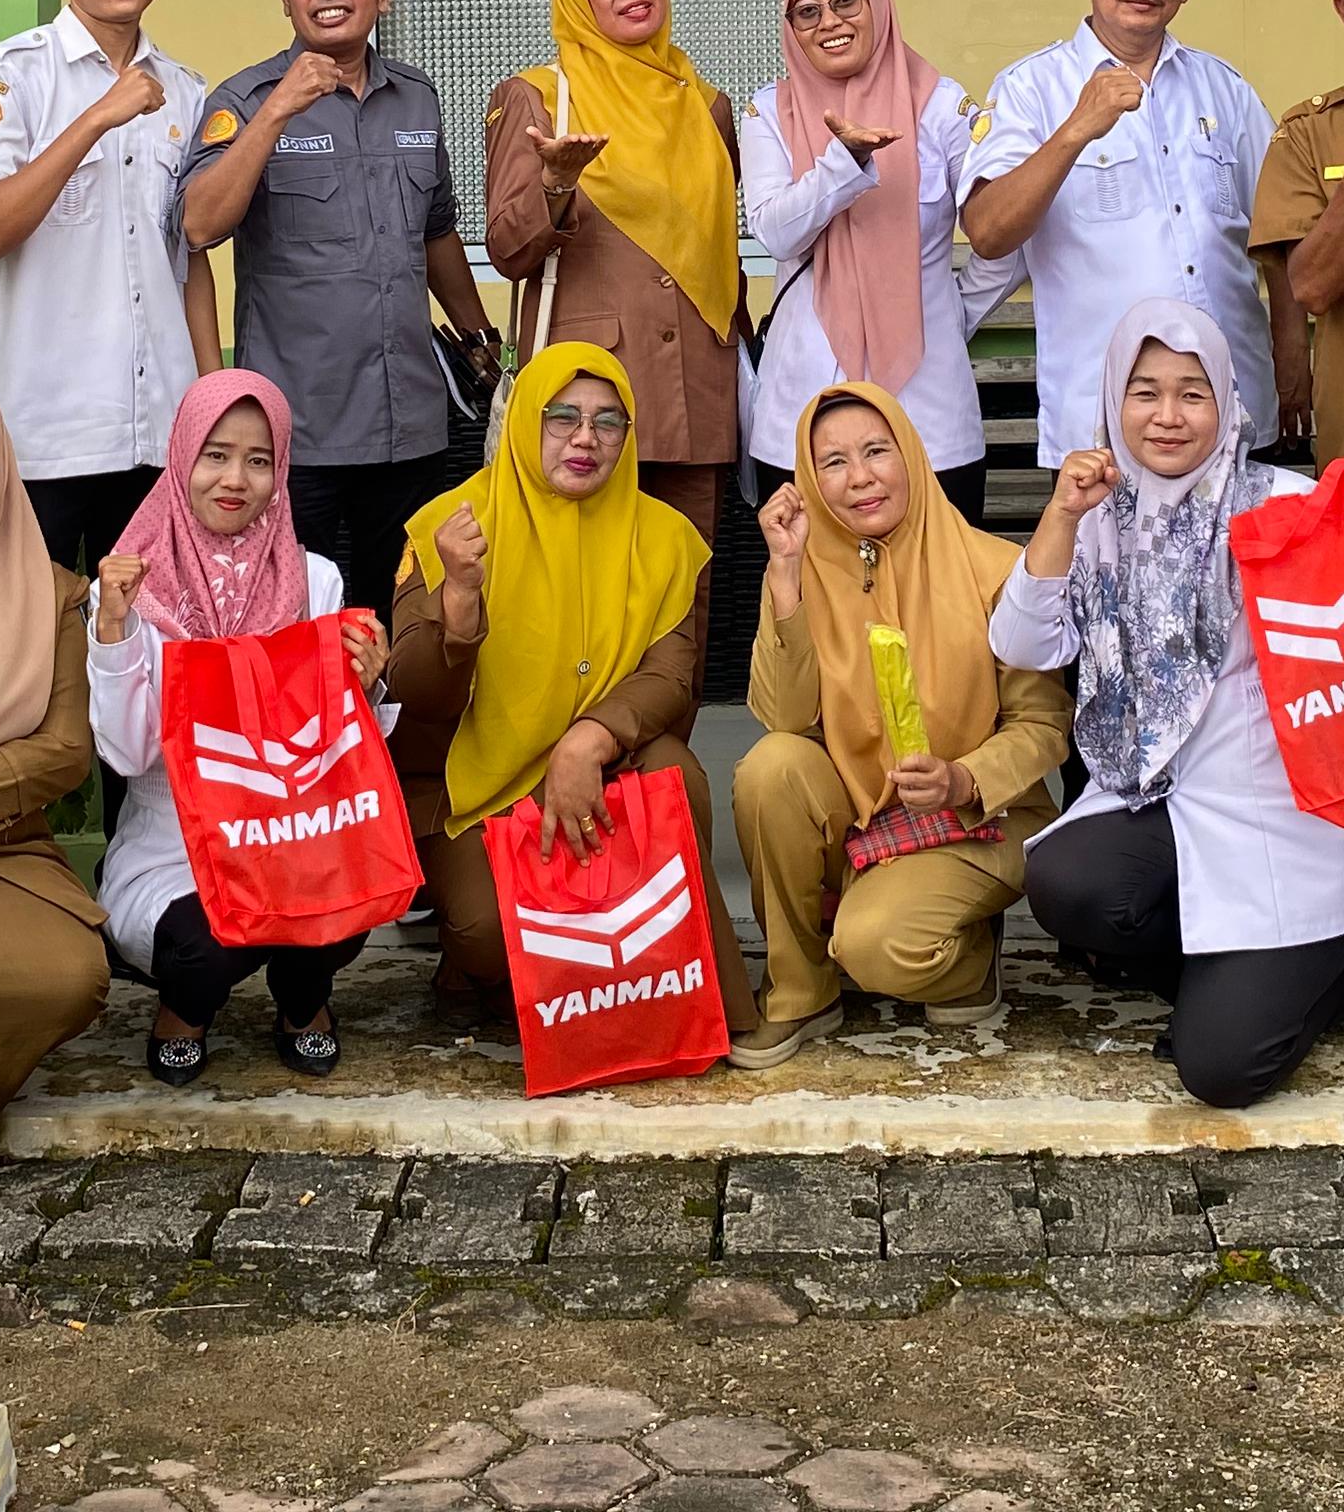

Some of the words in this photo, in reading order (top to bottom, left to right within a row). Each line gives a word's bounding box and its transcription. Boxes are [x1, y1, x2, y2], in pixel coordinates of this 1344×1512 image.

[280, 137, 329, 150] DONNY
[218, 789, 381, 849] YANMAR
[535, 958, 705, 1028] YANMAR
